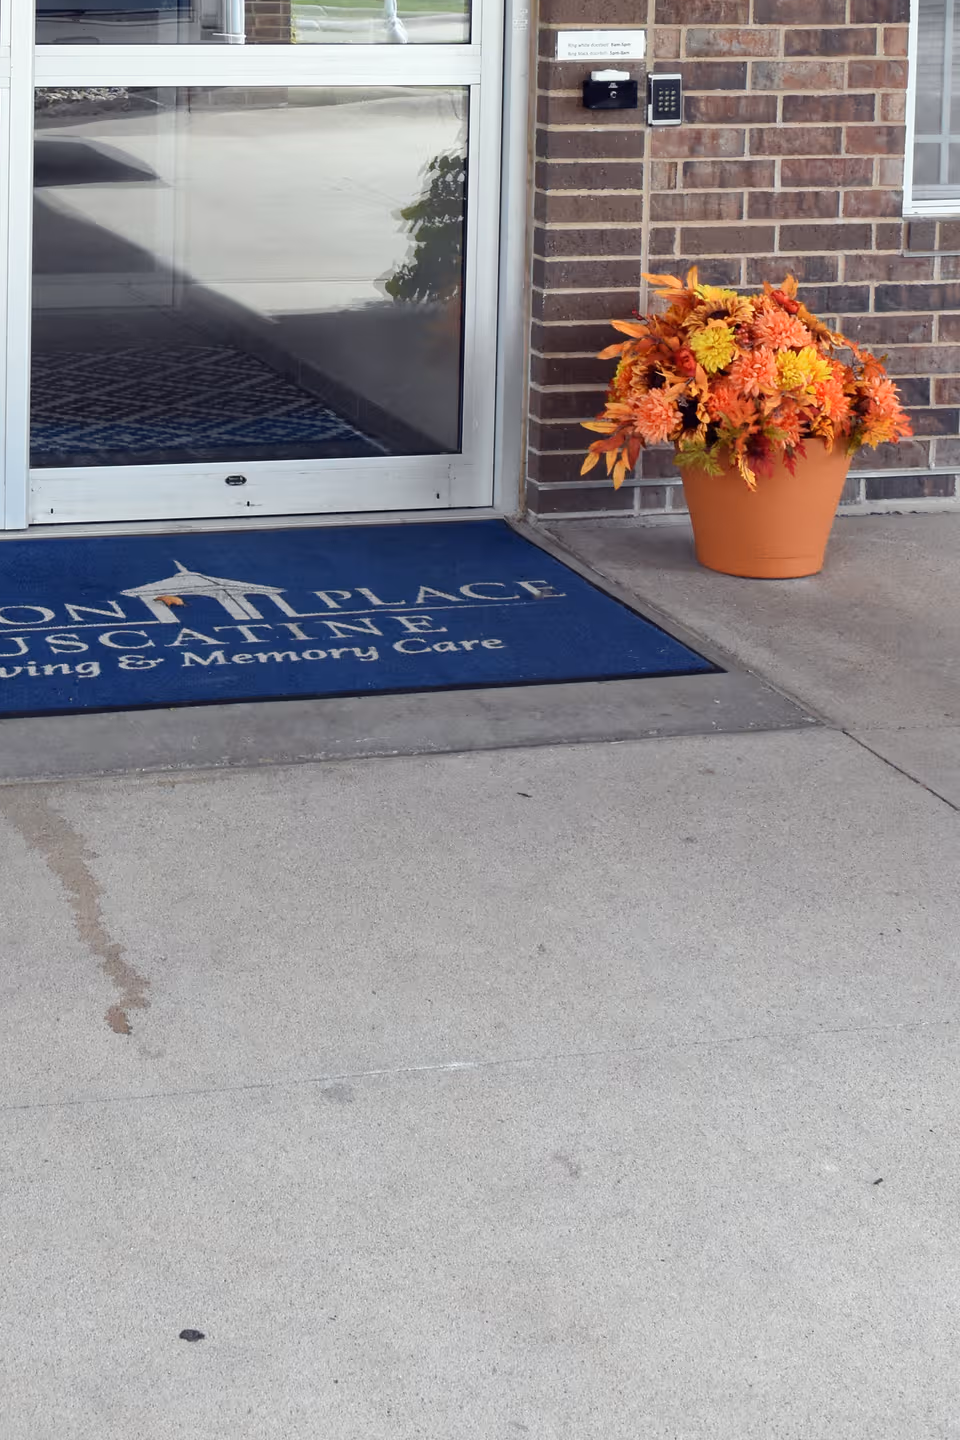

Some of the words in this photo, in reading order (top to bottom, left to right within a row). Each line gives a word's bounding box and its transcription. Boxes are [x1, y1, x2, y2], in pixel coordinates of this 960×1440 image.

[312, 580, 567, 609] PLACE
[117, 654, 165, 671] &
[181, 645, 380, 668] Memory
[392, 637, 507, 655] Care
